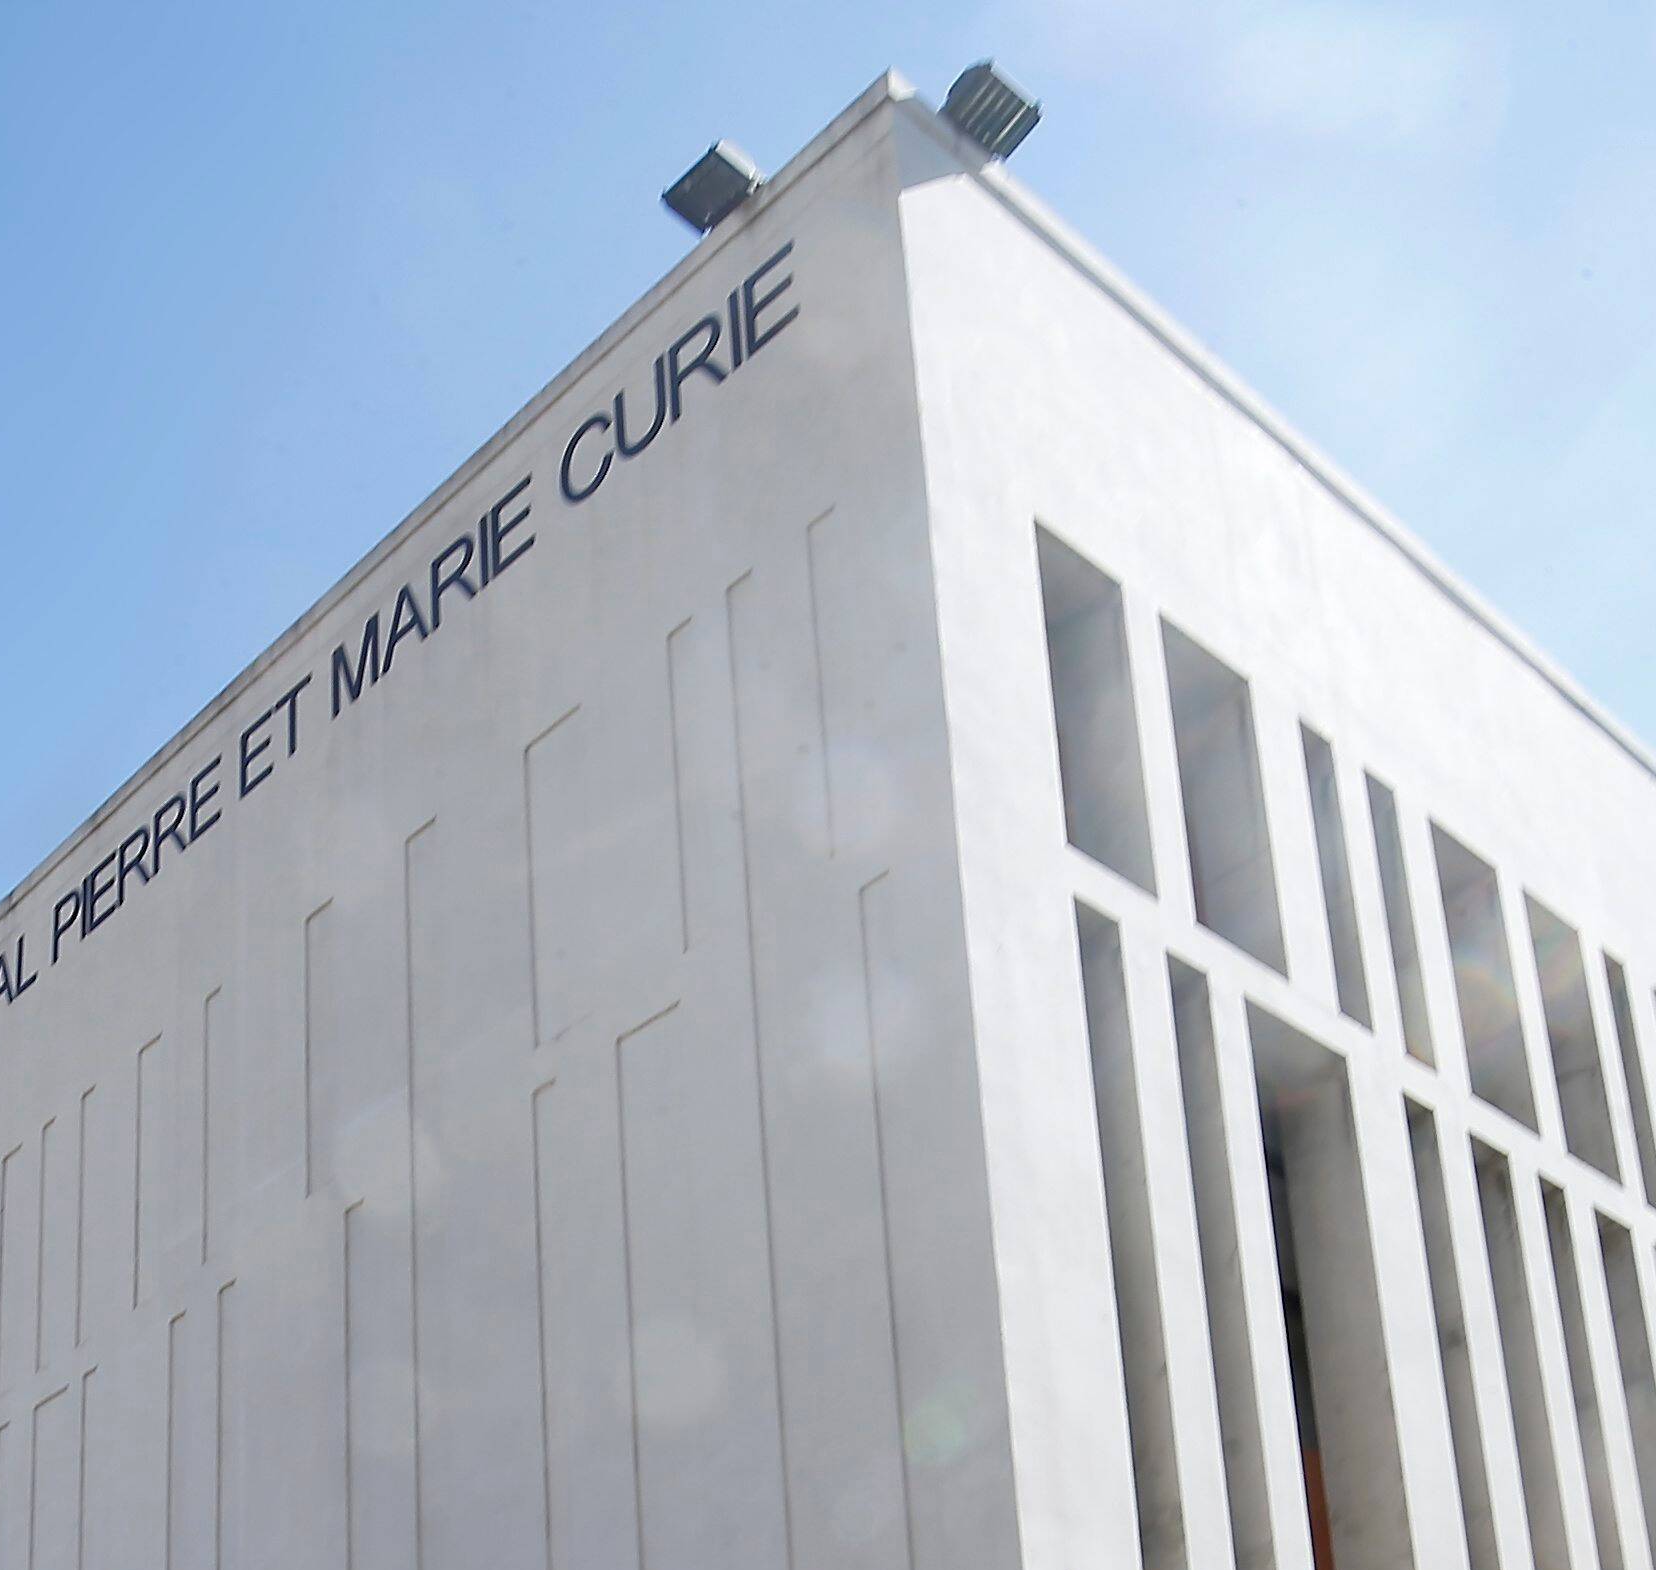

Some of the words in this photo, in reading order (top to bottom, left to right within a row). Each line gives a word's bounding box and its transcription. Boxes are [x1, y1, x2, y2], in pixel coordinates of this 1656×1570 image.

[51, 753, 223, 967] PIERRE
[238, 671, 313, 800] ET
[329, 471, 538, 721] MARIE
[558, 236, 802, 504] CURIE
